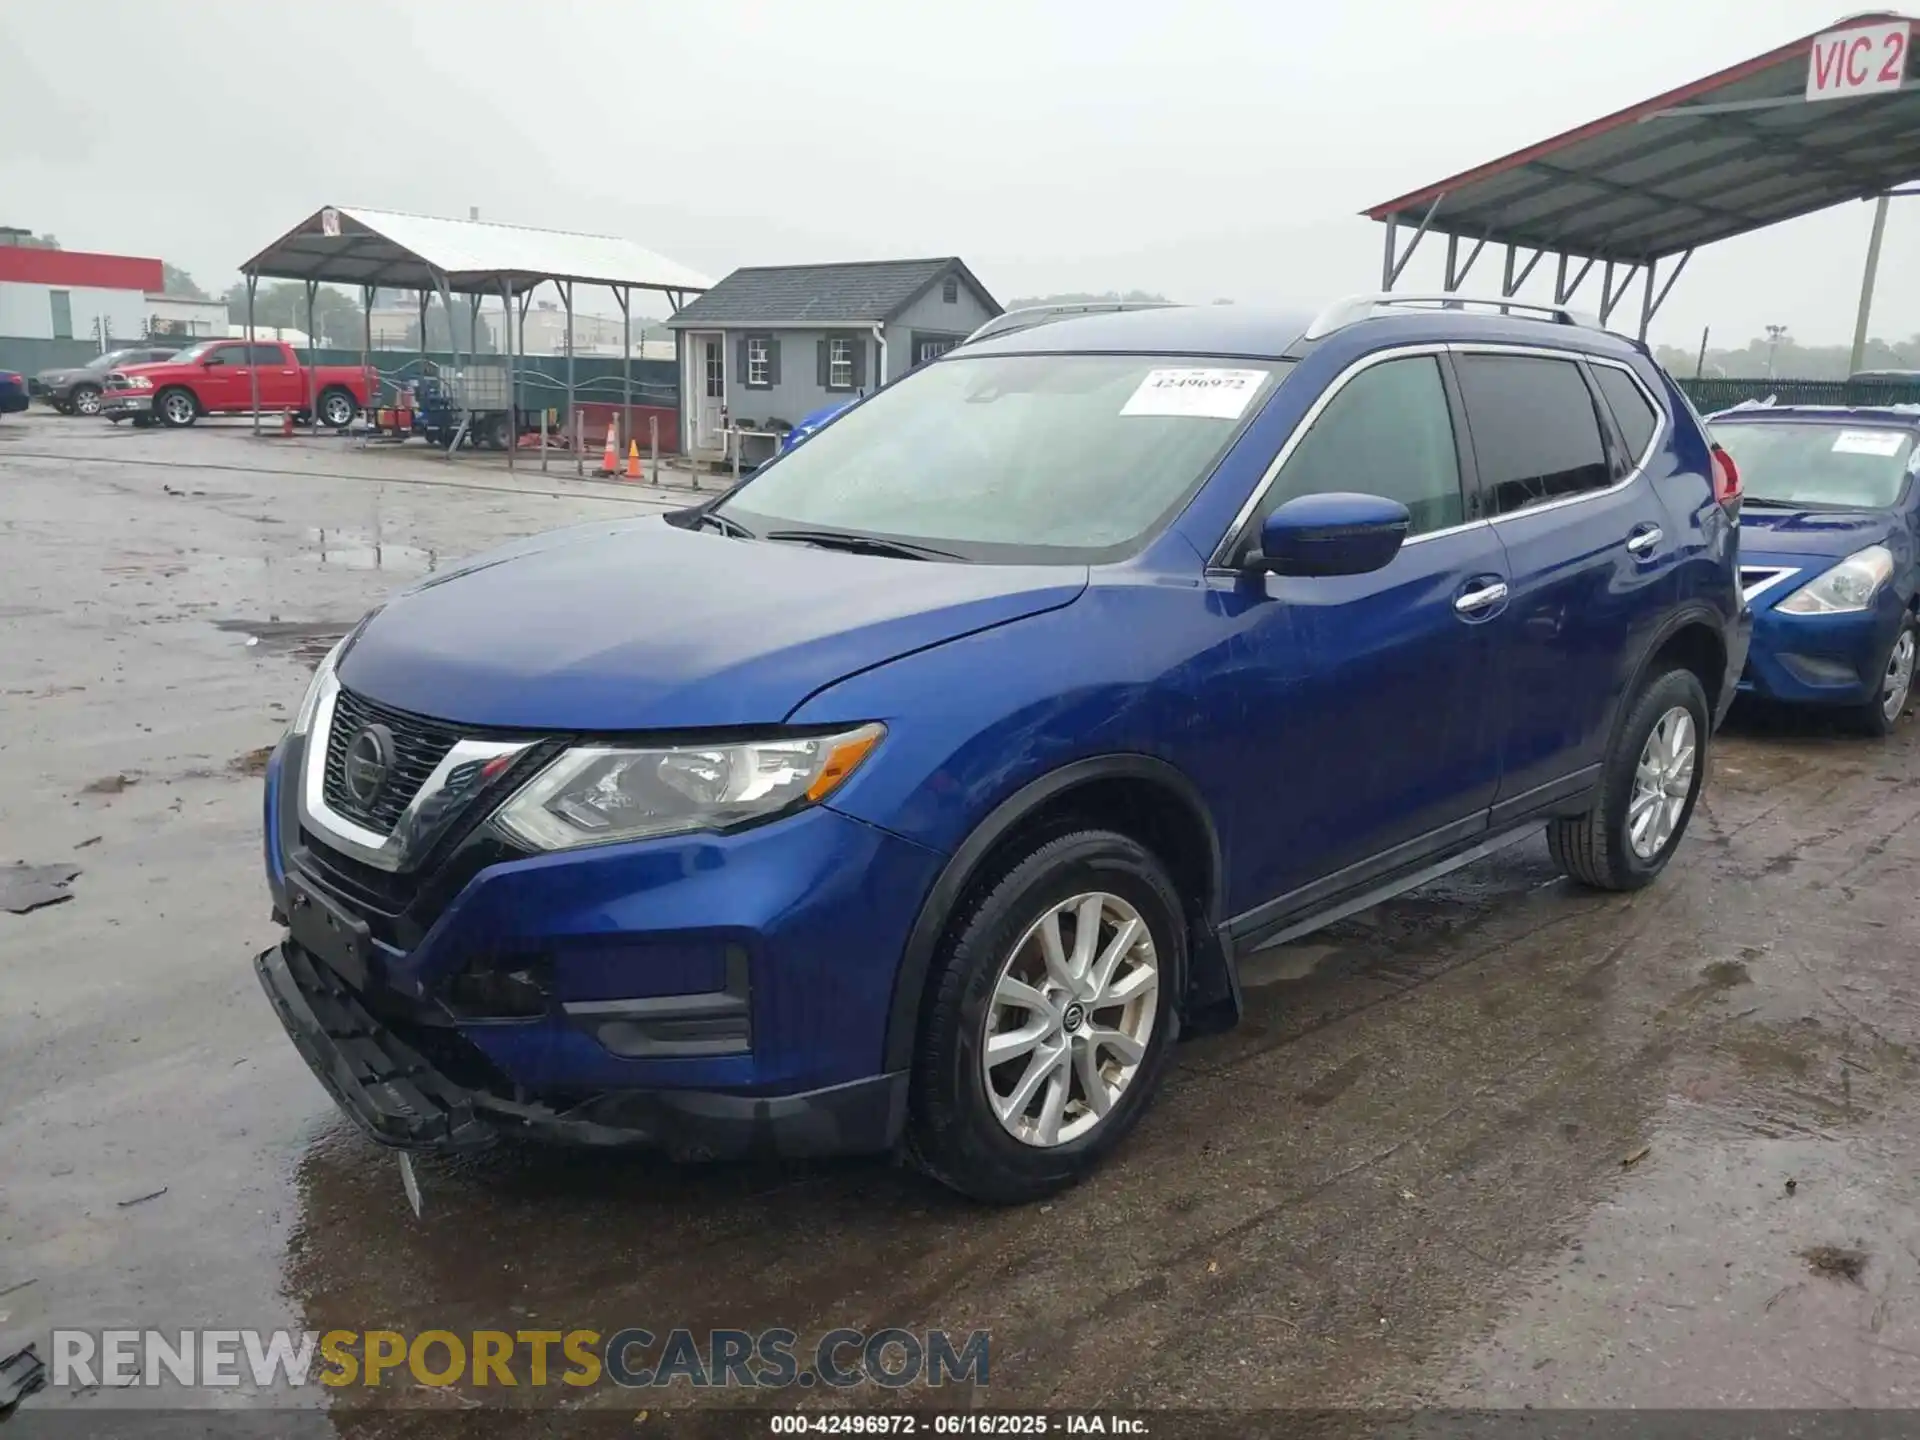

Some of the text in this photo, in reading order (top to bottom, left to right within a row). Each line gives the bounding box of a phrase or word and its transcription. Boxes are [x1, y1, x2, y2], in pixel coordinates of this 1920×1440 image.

[1815, 31, 1904, 90] VIC 2
[1151, 378, 1246, 390] 42496972
